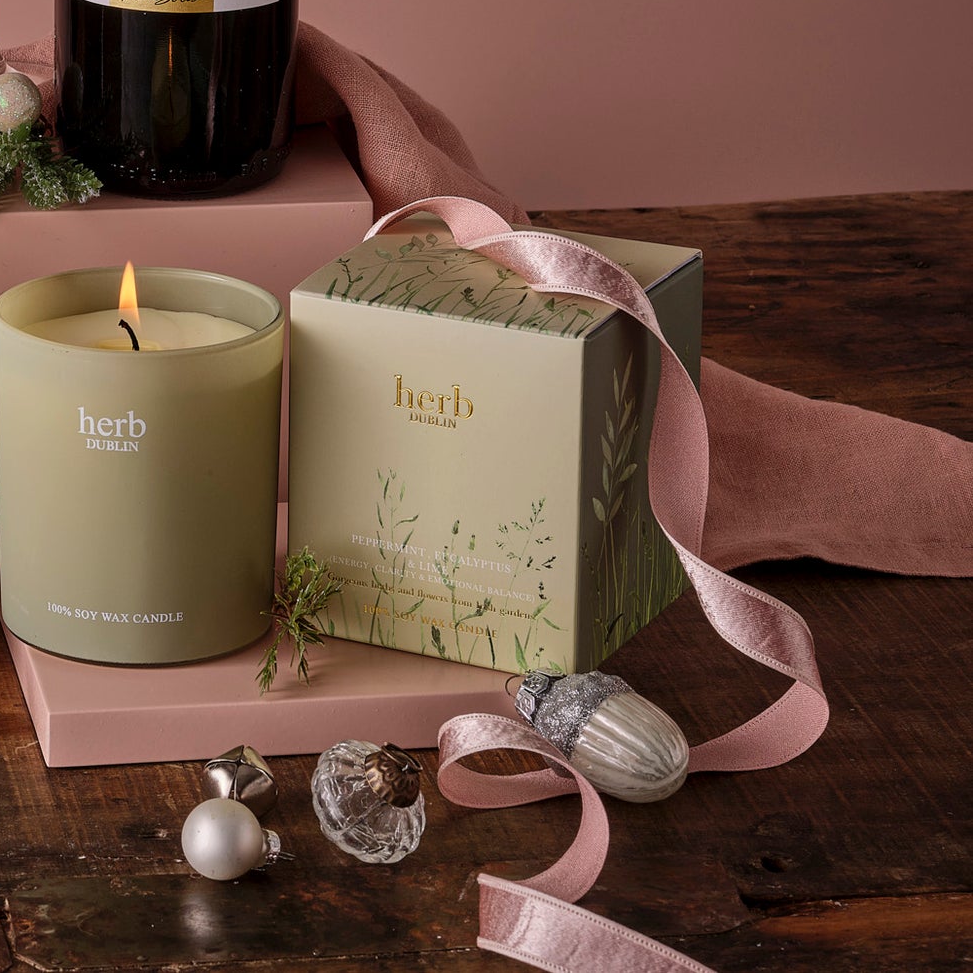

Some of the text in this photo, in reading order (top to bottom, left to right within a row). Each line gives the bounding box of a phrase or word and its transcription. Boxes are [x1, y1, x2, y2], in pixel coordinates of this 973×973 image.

[393, 373, 474, 420] herb
[77, 406, 147, 438] herb
[409, 411, 458, 429] DUBLIN
[85, 438, 140, 452] DUBLIN
[408, 559, 450, 576] & LIME
[434, 550, 512, 574] EUCALYPTUS
[374, 564, 417, 580] CLARITY
[418, 573, 426, 582] &
[428, 573, 486, 593] EMOTIONAL
[487, 586, 536, 604] BALANCE)
[397, 586, 415, 596] and
[417, 589, 449, 603] flowers
[45, 601, 185, 624] 100% SOY WAX CANDLE
[394, 610, 417, 623] SOY
[420, 615, 446, 629] WAX
[449, 621, 498, 639] CANDLE
